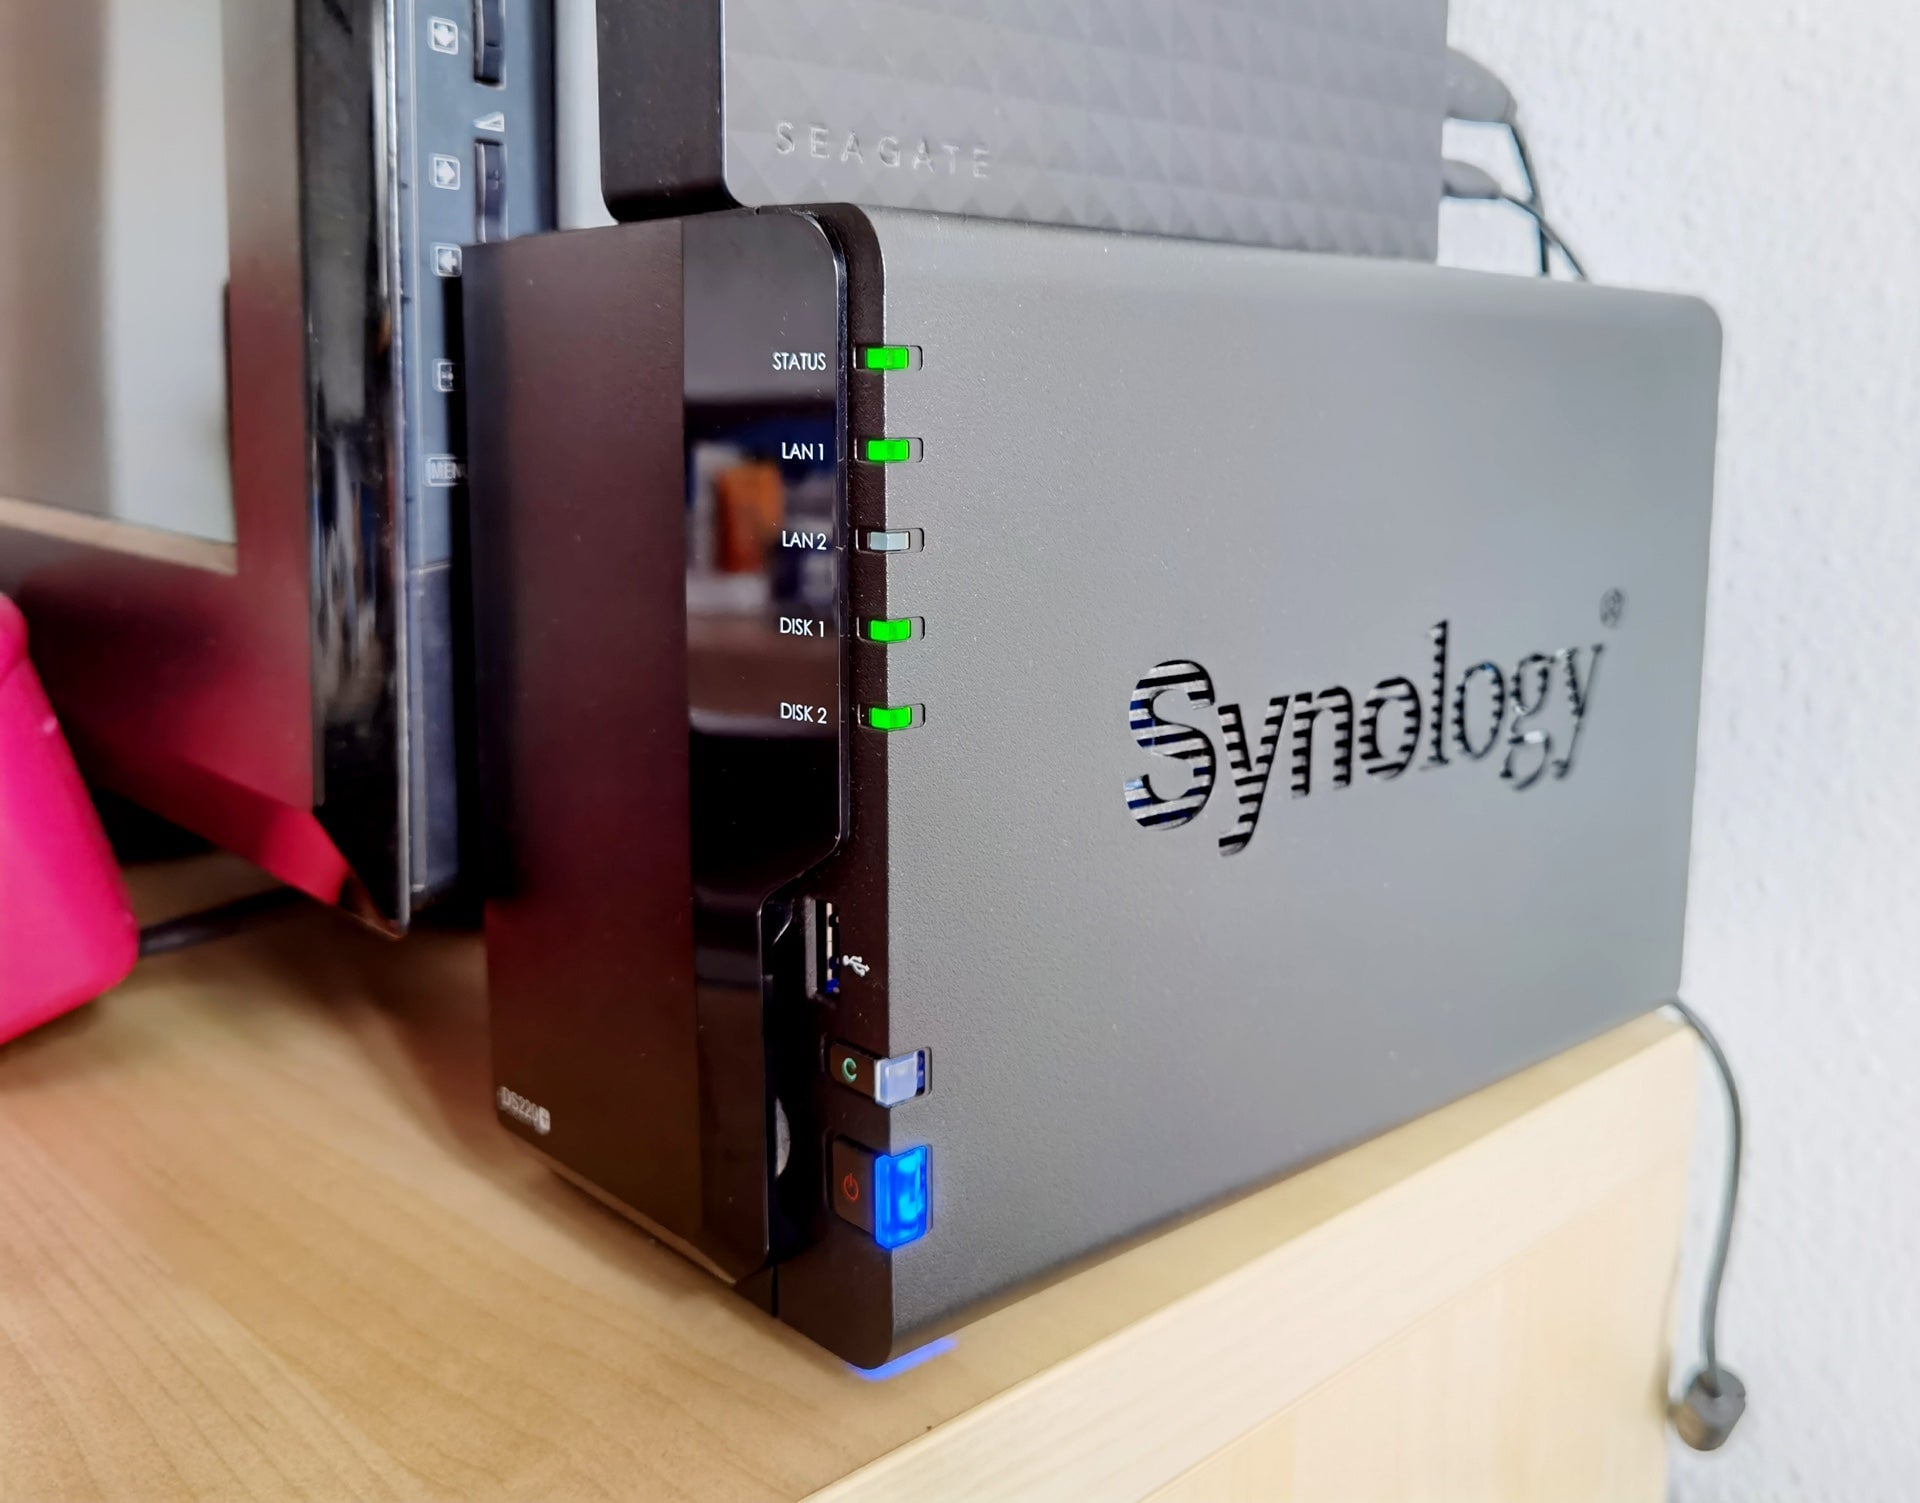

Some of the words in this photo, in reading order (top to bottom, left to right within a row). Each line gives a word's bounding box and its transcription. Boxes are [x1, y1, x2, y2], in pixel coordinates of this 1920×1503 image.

[776, 120, 990, 179] SEAGATE
[772, 351, 827, 371] STATUS
[781, 442, 813, 461] LAN
[818, 442, 825, 460] 1
[782, 530, 815, 550] LAN
[816, 532, 828, 551] 2
[779, 617, 814, 637] DISK
[818, 620, 826, 638] 1
[780, 702, 814, 723] DISK
[817, 705, 828, 725] 2
